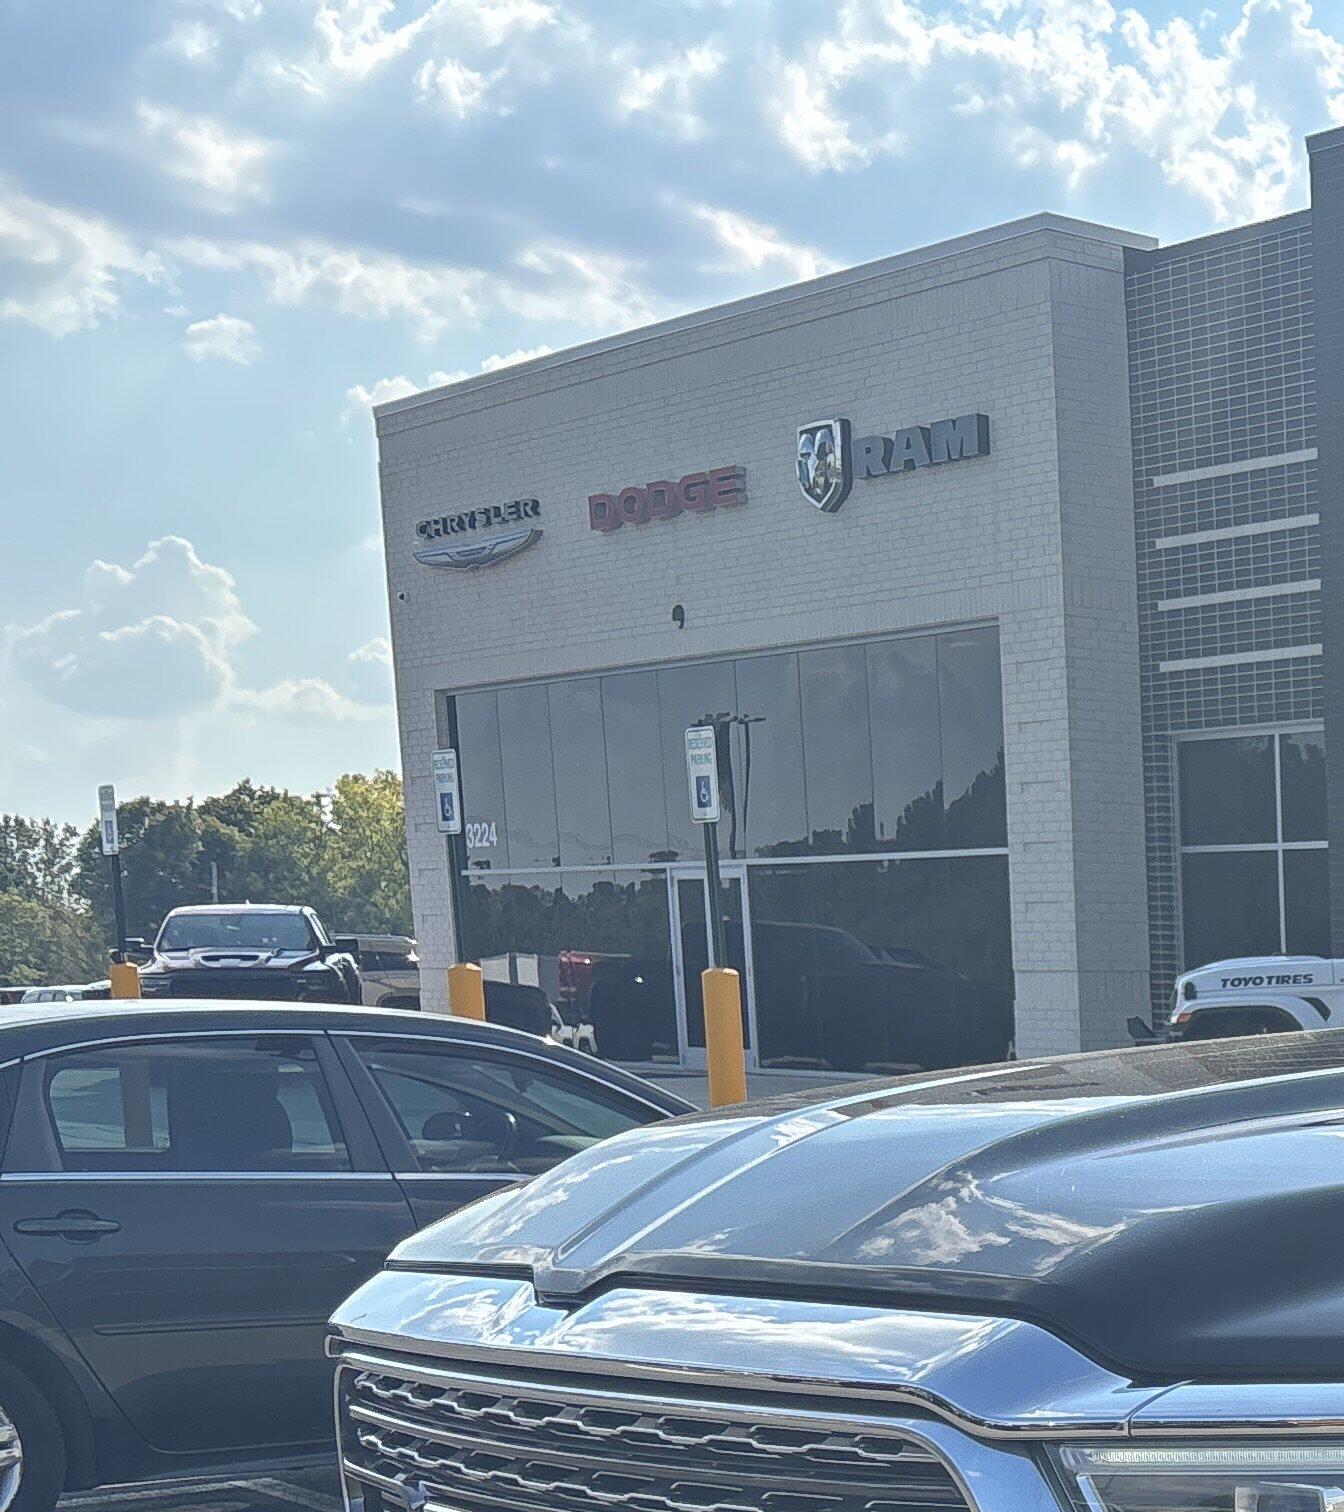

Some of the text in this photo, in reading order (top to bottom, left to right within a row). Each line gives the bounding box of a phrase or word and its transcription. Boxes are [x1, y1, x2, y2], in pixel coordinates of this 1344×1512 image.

[852, 412, 990, 479] RAM
[416, 498, 541, 539] CHRYSLER
[588, 465, 747, 532] DODGE
[465, 821, 498, 848] 3224
[1221, 973, 1314, 988] TOYO TIRES
